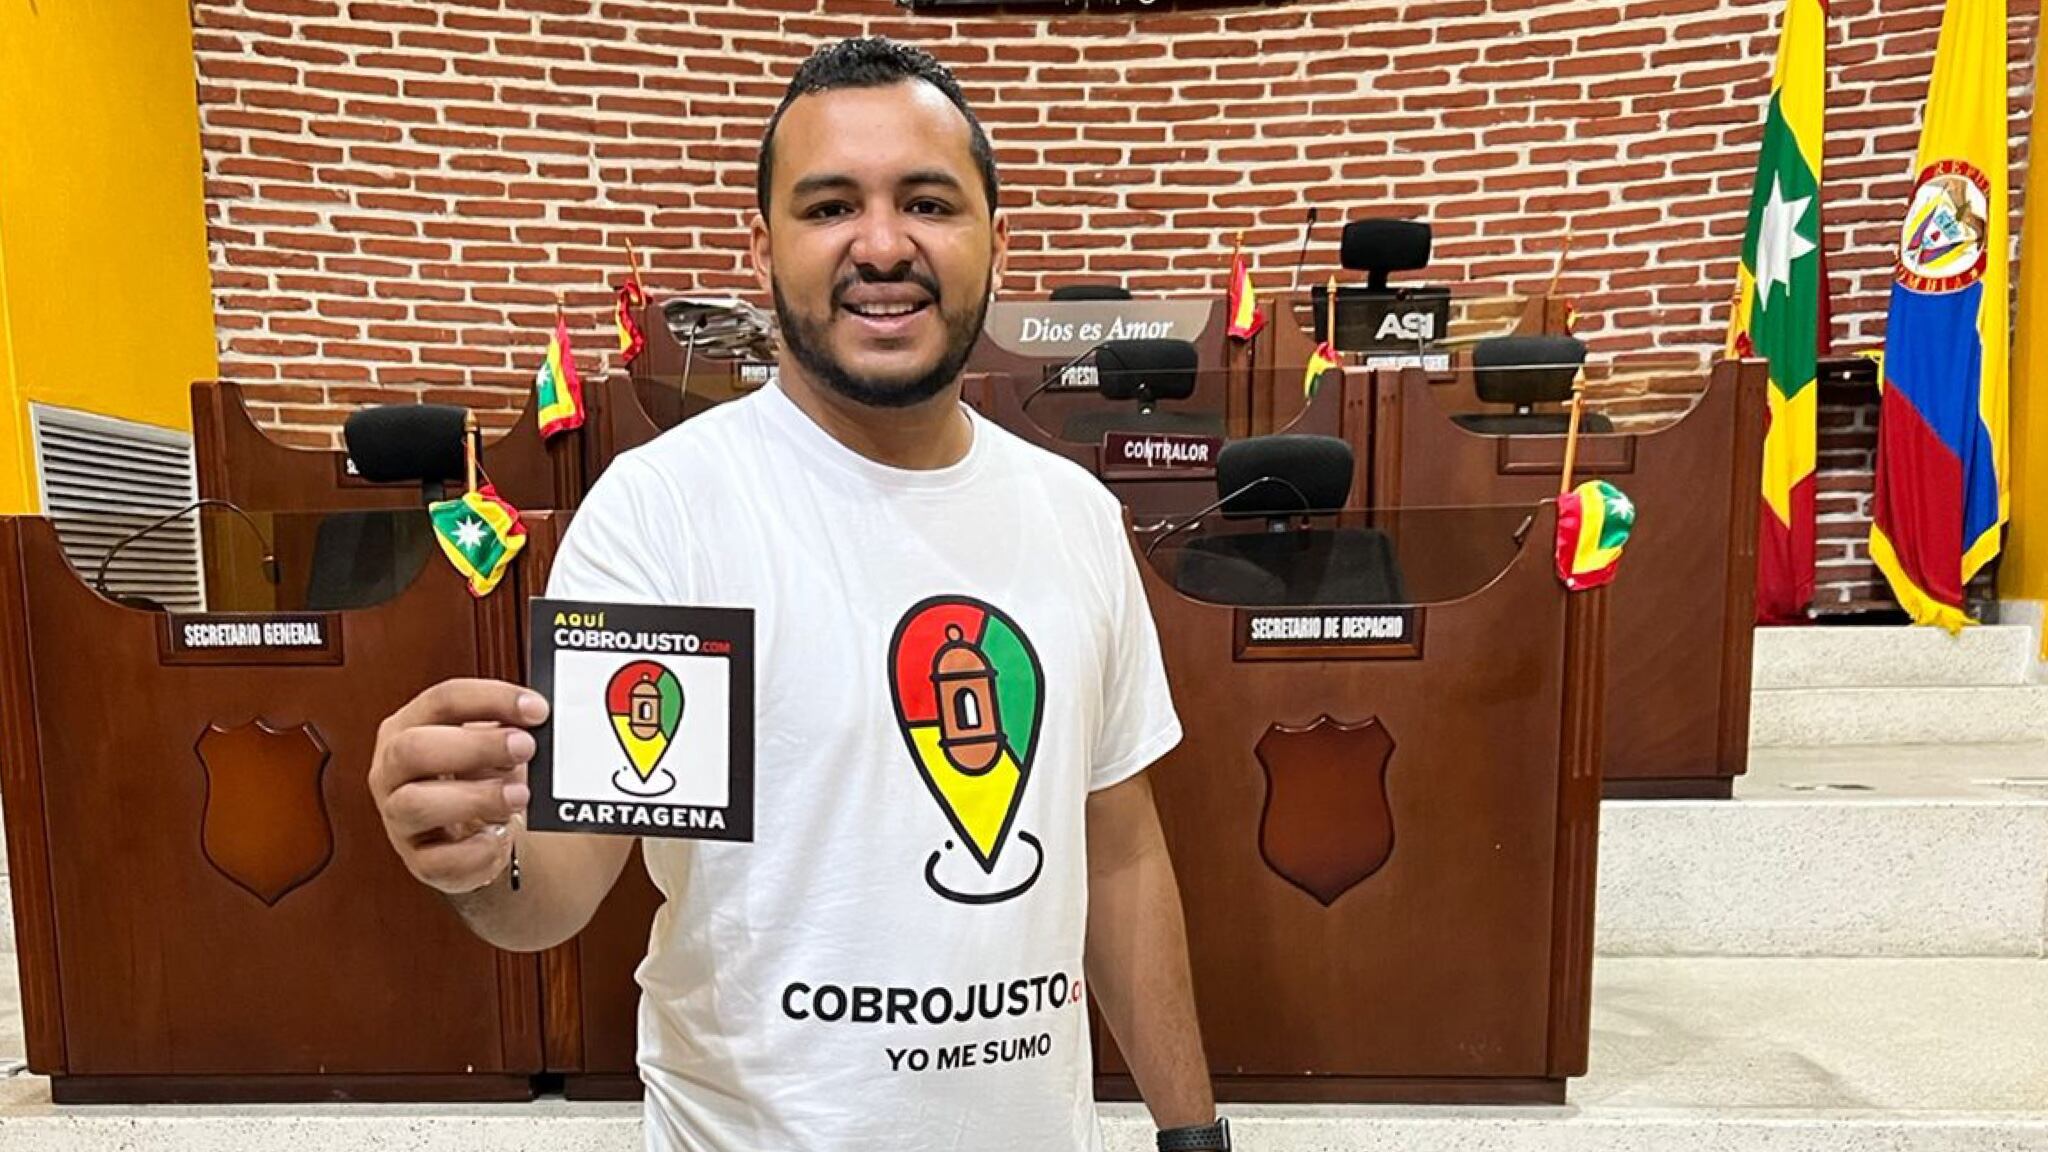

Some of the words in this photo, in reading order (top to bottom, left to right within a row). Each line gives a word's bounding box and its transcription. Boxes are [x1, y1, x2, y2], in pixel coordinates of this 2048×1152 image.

[1019, 316, 1073, 342] Dios
[1079, 323, 1102, 341] es
[1106, 315, 1174, 341] Amor
[1124, 440, 1209, 462] CONTRALOR
[554, 612, 604, 628] AQUÍ
[1251, 616, 1321, 640] SECRETARIO
[1323, 616, 1340, 639] DE
[1341, 615, 1403, 638] DESPACHO
[184, 622, 261, 648] SECRETARIO
[263, 622, 323, 646] GENERAL
[558, 802, 727, 830] CARTAGENA
[781, 971, 1082, 1025] COBROJUSTO.C
[886, 1048, 930, 1072] YO
[936, 1043, 978, 1071] ME
[983, 1032, 1051, 1064] SUMO
